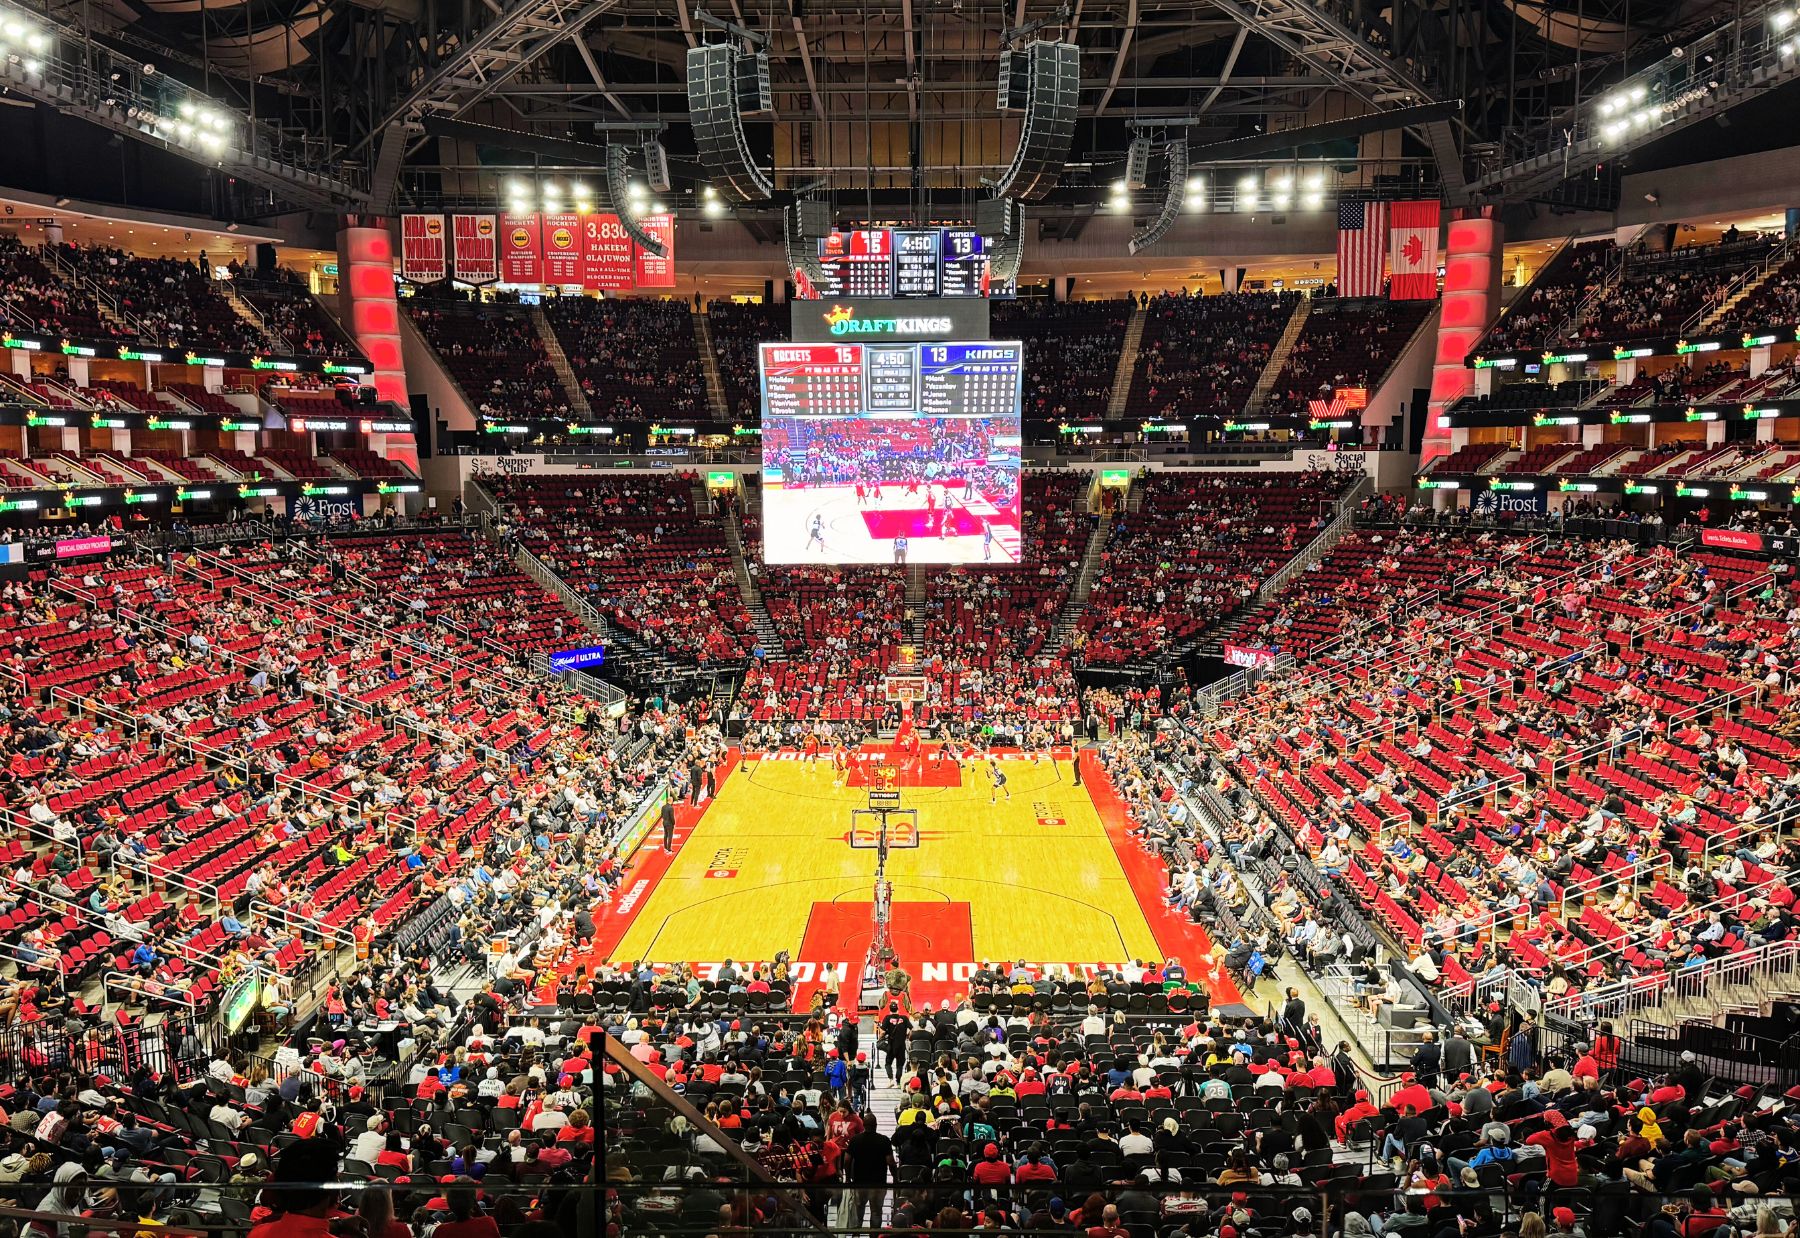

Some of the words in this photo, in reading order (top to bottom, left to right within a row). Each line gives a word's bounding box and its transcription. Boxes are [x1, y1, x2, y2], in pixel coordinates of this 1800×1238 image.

[403, 216, 426, 237] NBA
[455, 216, 477, 237] NBA
[405, 238, 443, 259] WORLD
[456, 238, 494, 259] WORLD
[864, 239, 881, 253] 15
[902, 237, 932, 250] 4:50
[953, 238, 971, 253] 13
[586, 255, 630, 263] OLAJUWON
[830, 318, 952, 334] DRAFTKINGS
[773, 349, 812, 362] ROCKETS
[835, 347, 853, 363] 15
[877, 353, 905, 365] 4:50
[930, 347, 948, 362] 13
[965, 349, 1015, 359] KINGS
[305, 421, 329, 430] TUNDRA
[497, 456, 536, 468] Supper
[1335, 452, 1366, 463] Social
[1338, 460, 1362, 469] Club
[503, 464, 527, 474] Club
[318, 499, 356, 516] Frost
[1500, 494, 1538, 512] Frost
[580, 651, 601, 662] ULTRA
[1209, 1087, 1224, 1097] 25
